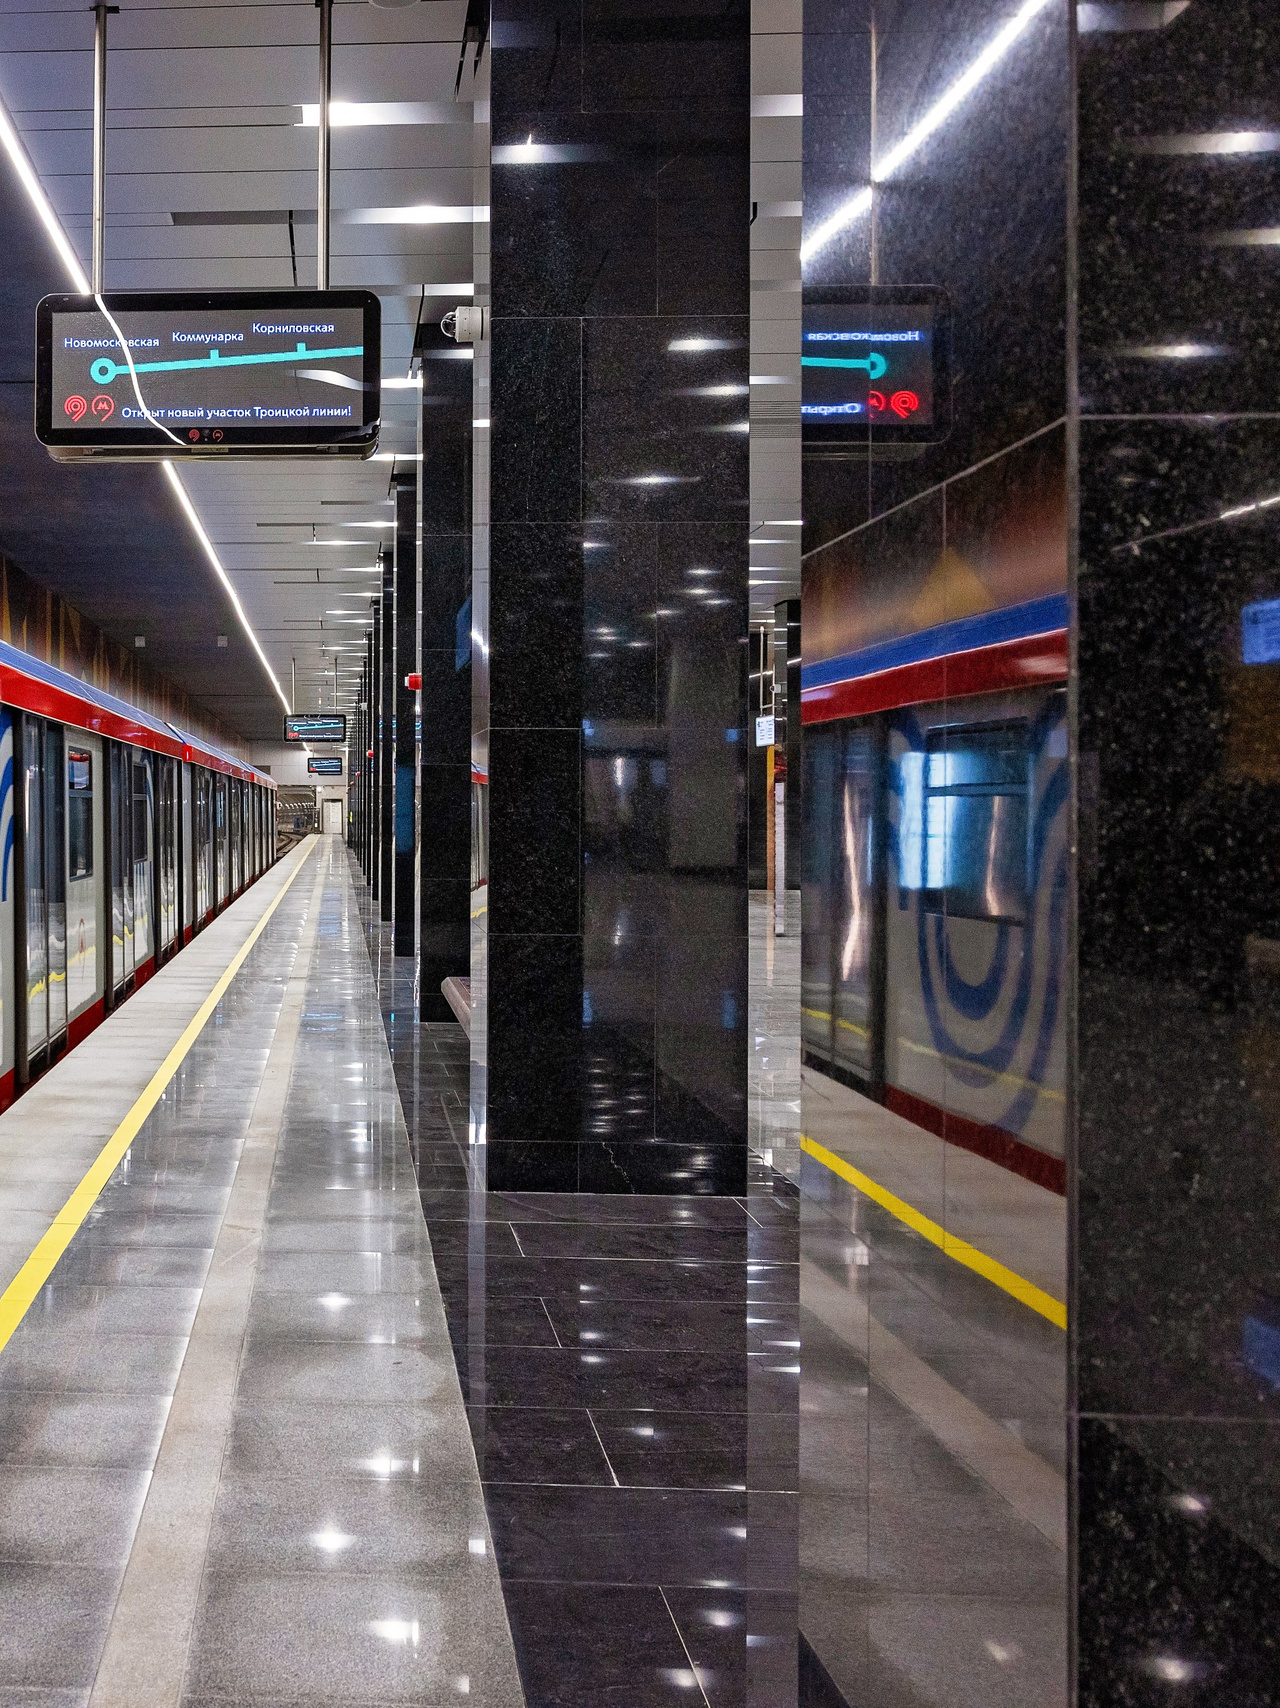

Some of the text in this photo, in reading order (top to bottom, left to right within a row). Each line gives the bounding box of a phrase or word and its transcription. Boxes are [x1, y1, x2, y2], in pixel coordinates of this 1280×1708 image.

[252, 323, 335, 335] Корниловская
[172, 331, 244, 344] Коммунарка
[167, 405, 205, 418] новый
[206, 408, 252, 420] участок
[253, 406, 310, 419] Троицкой
[312, 405, 352, 417] линии!
